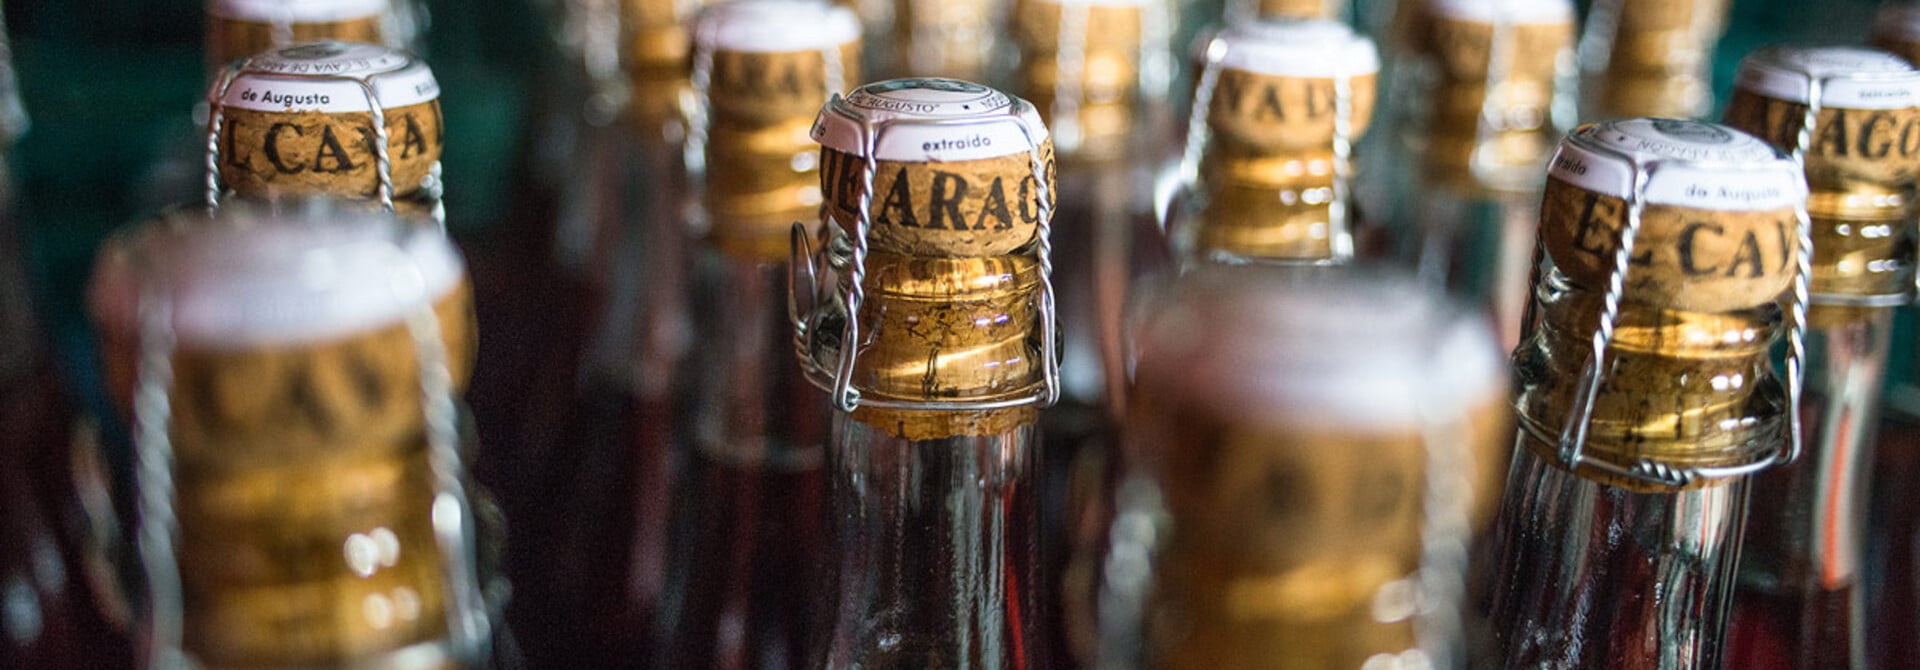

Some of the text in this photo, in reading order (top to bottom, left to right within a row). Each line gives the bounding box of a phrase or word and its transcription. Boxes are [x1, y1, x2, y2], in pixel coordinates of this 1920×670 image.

[240, 87, 331, 108] de Augusta
[921, 135, 992, 153] extraido
